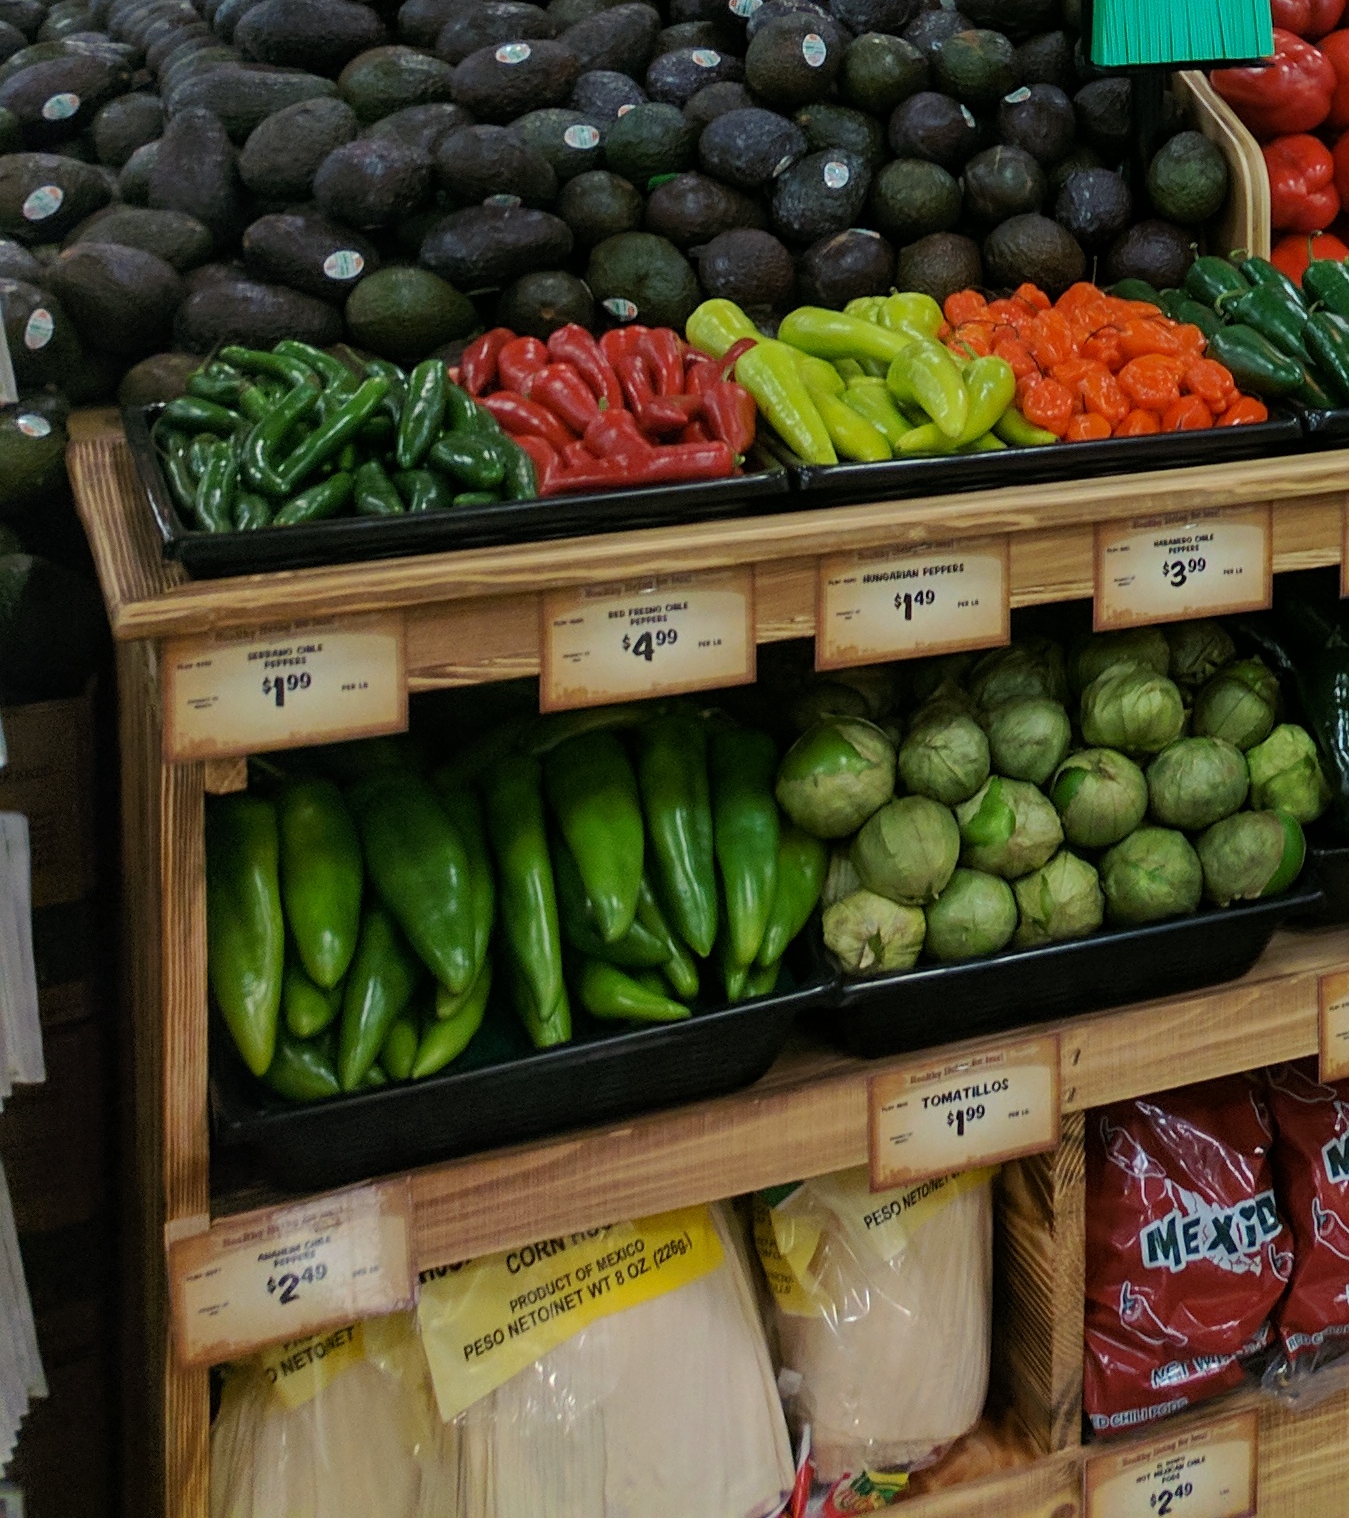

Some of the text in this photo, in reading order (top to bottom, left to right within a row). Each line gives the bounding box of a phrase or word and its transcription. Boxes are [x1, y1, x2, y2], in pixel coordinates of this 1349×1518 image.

[922, 563, 964, 577] PEPPERS
[921, 1078, 1009, 1109] TOMATILLOS
[863, 1201, 902, 1230] PESO
[505, 1236, 566, 1276] CORN
[509, 1238, 645, 1314] PRODUCT OF MEXICO
[463, 1327, 505, 1362] PESO
[507, 1290, 584, 1339] NETO/NET
[588, 1276, 612, 1300] WT
[614, 1270, 625, 1286] 8
